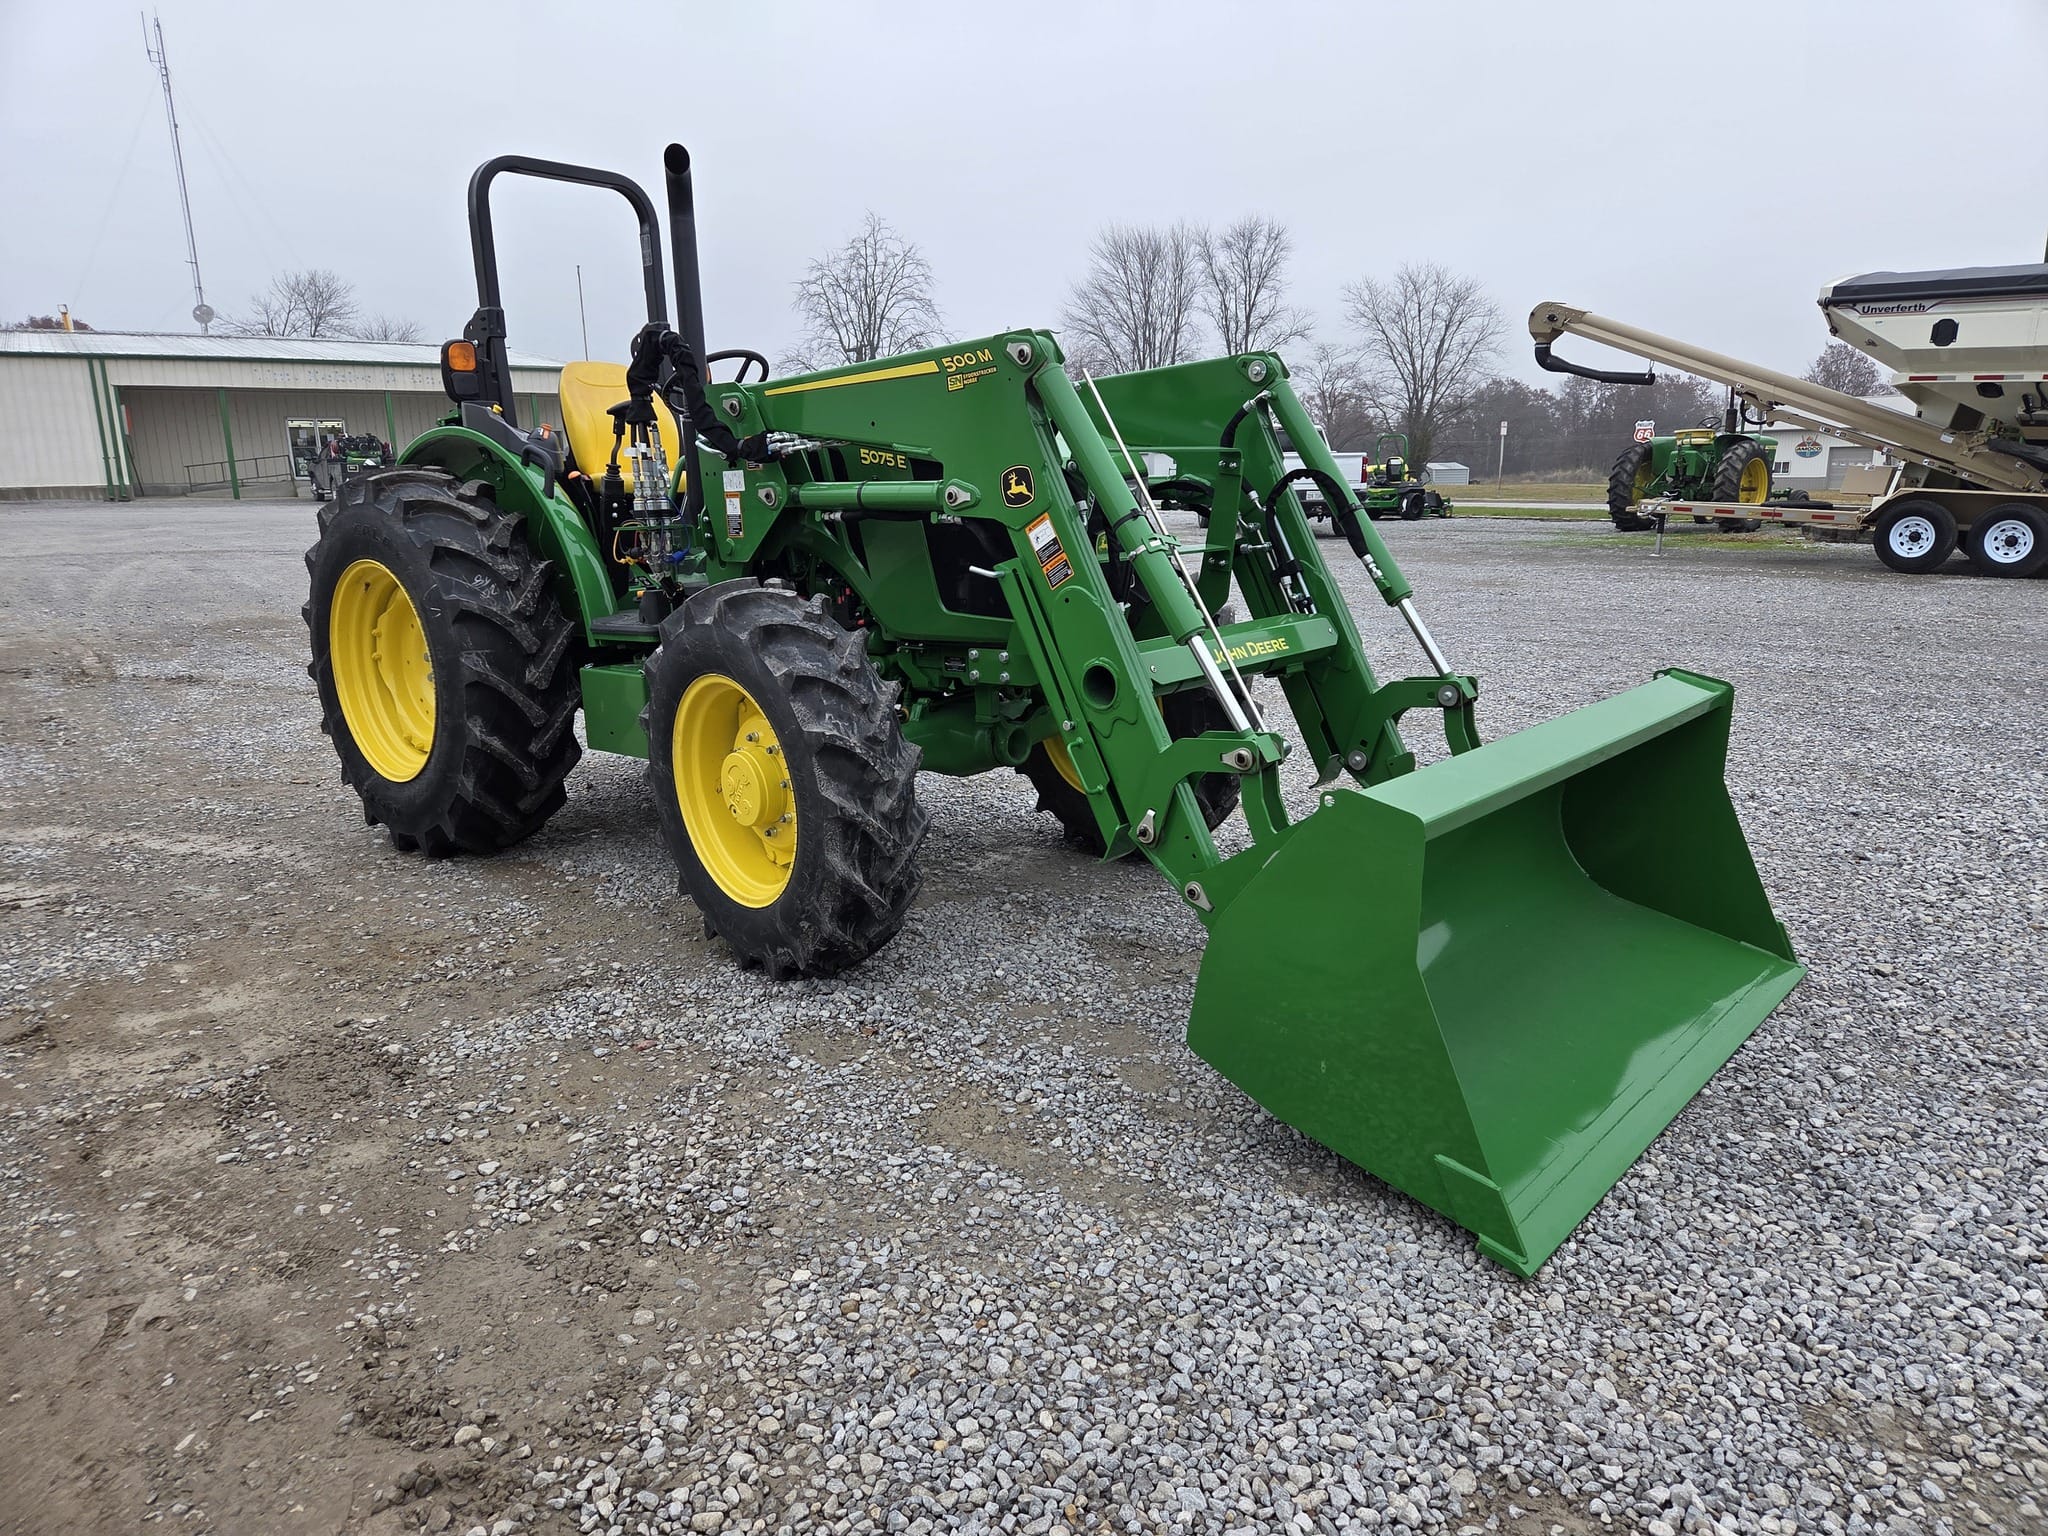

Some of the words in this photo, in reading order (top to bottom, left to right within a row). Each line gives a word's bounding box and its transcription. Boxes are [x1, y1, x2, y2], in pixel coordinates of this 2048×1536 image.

[1861, 302, 1926, 314] Unverferth
[941, 352, 977, 372] 500
[976, 348, 994, 363] M
[1636, 429, 1652, 440] 66
[860, 448, 896, 467] 5075
[896, 454, 907, 469] E
[1245, 637, 1290, 657] DEERE
